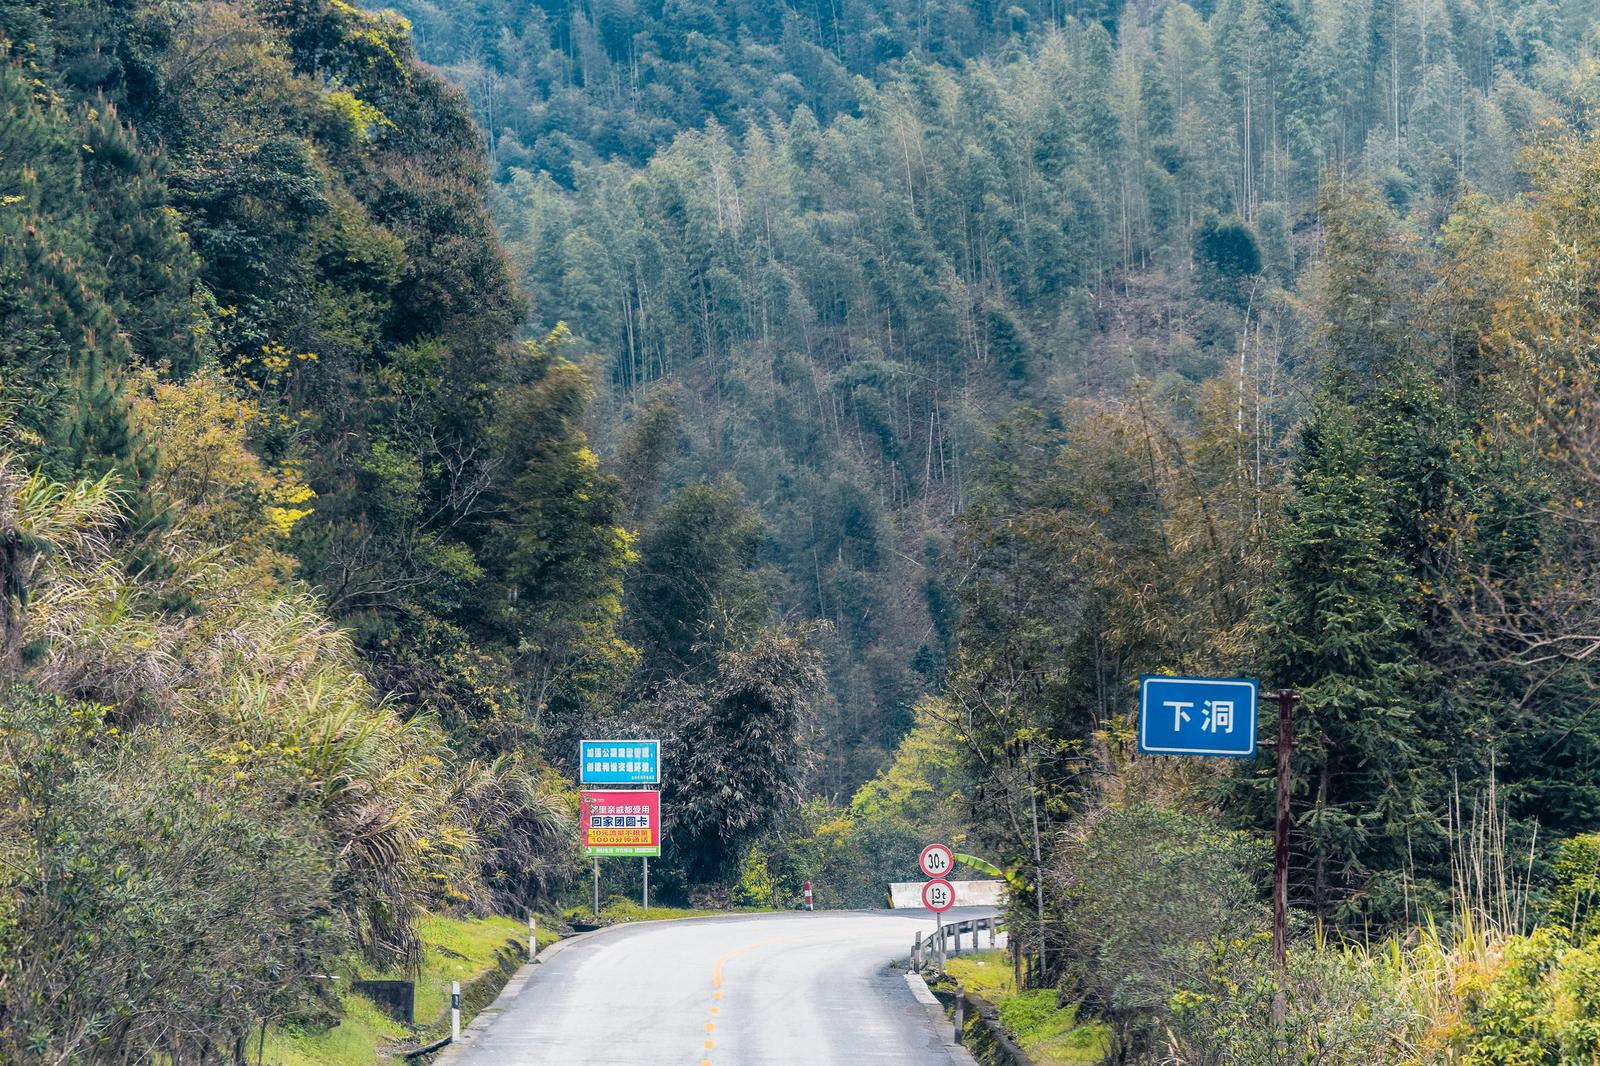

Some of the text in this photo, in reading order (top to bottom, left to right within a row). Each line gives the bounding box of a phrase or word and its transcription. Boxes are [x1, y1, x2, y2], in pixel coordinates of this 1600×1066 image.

[1162, 699, 1234, 734] 下洞
[591, 816, 648, 827] 回家团圆卡
[928, 853, 945, 869] 30t
[931, 888, 946, 900] 13t
